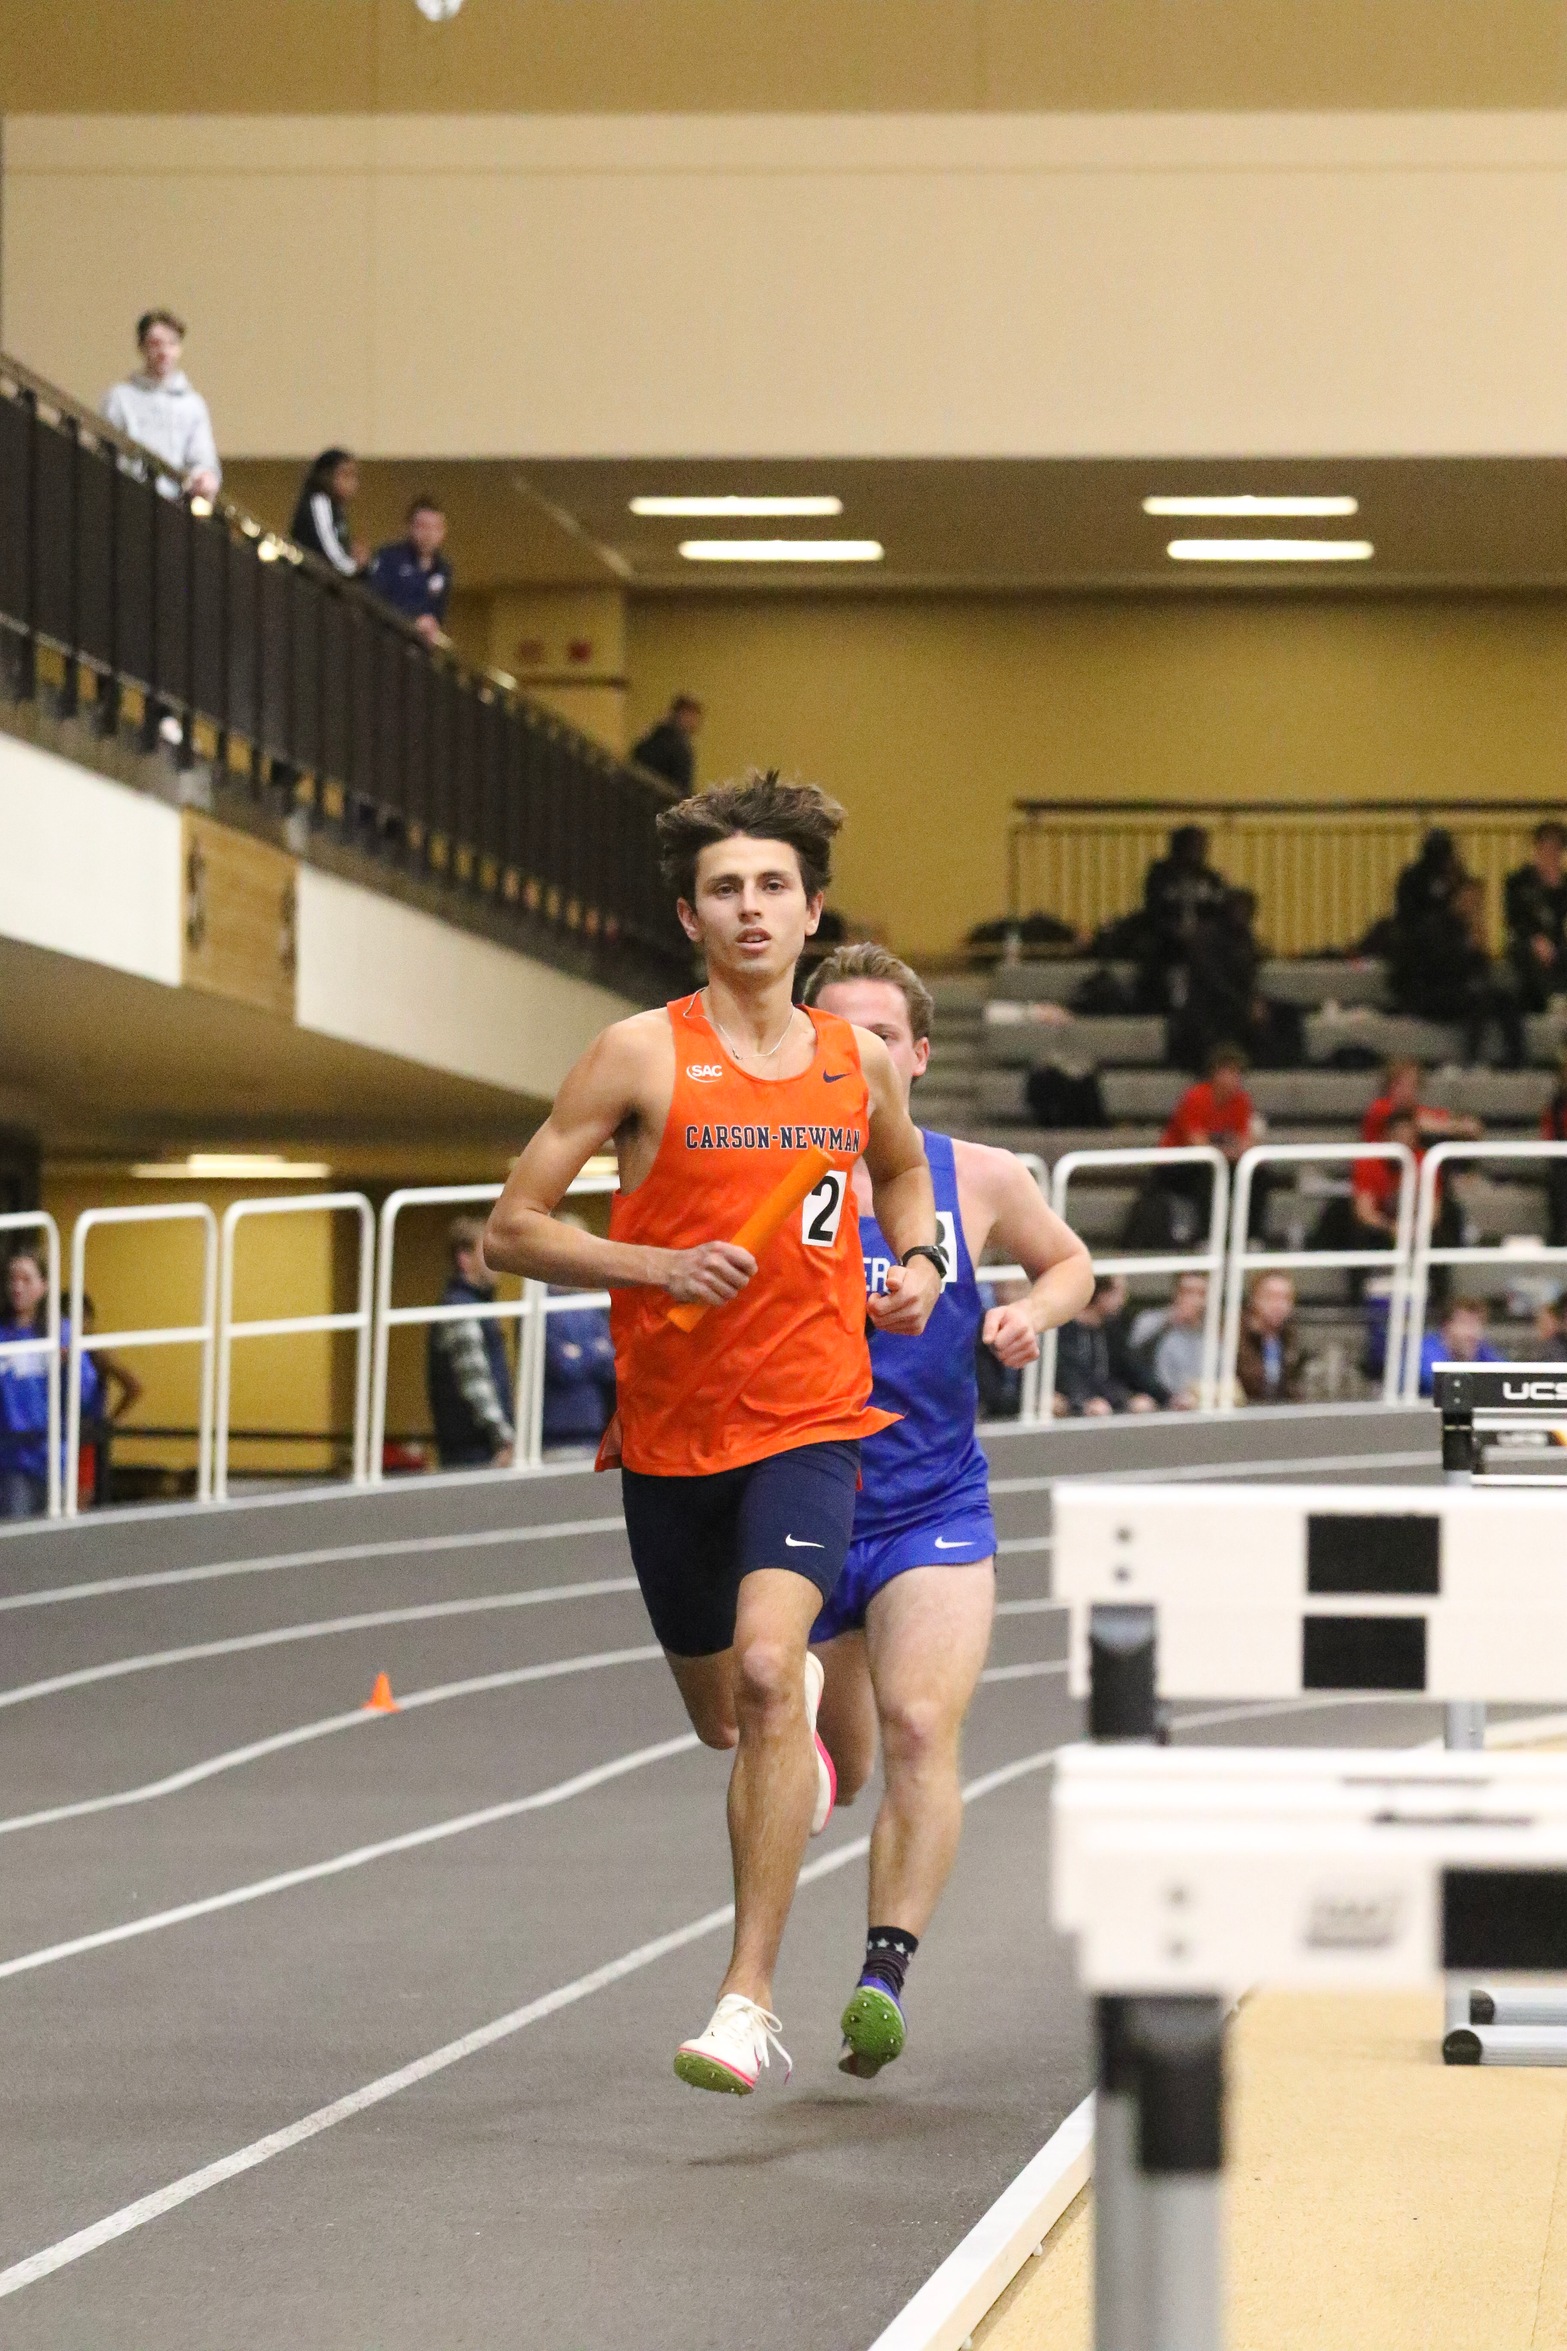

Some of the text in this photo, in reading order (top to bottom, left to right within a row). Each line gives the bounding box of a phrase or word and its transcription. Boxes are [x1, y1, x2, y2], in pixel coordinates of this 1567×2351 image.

[691, 1064, 723, 1077] SAC
[685, 1124, 860, 1153] CARSON-NEWMAN
[807, 1175, 839, 1242] 2
